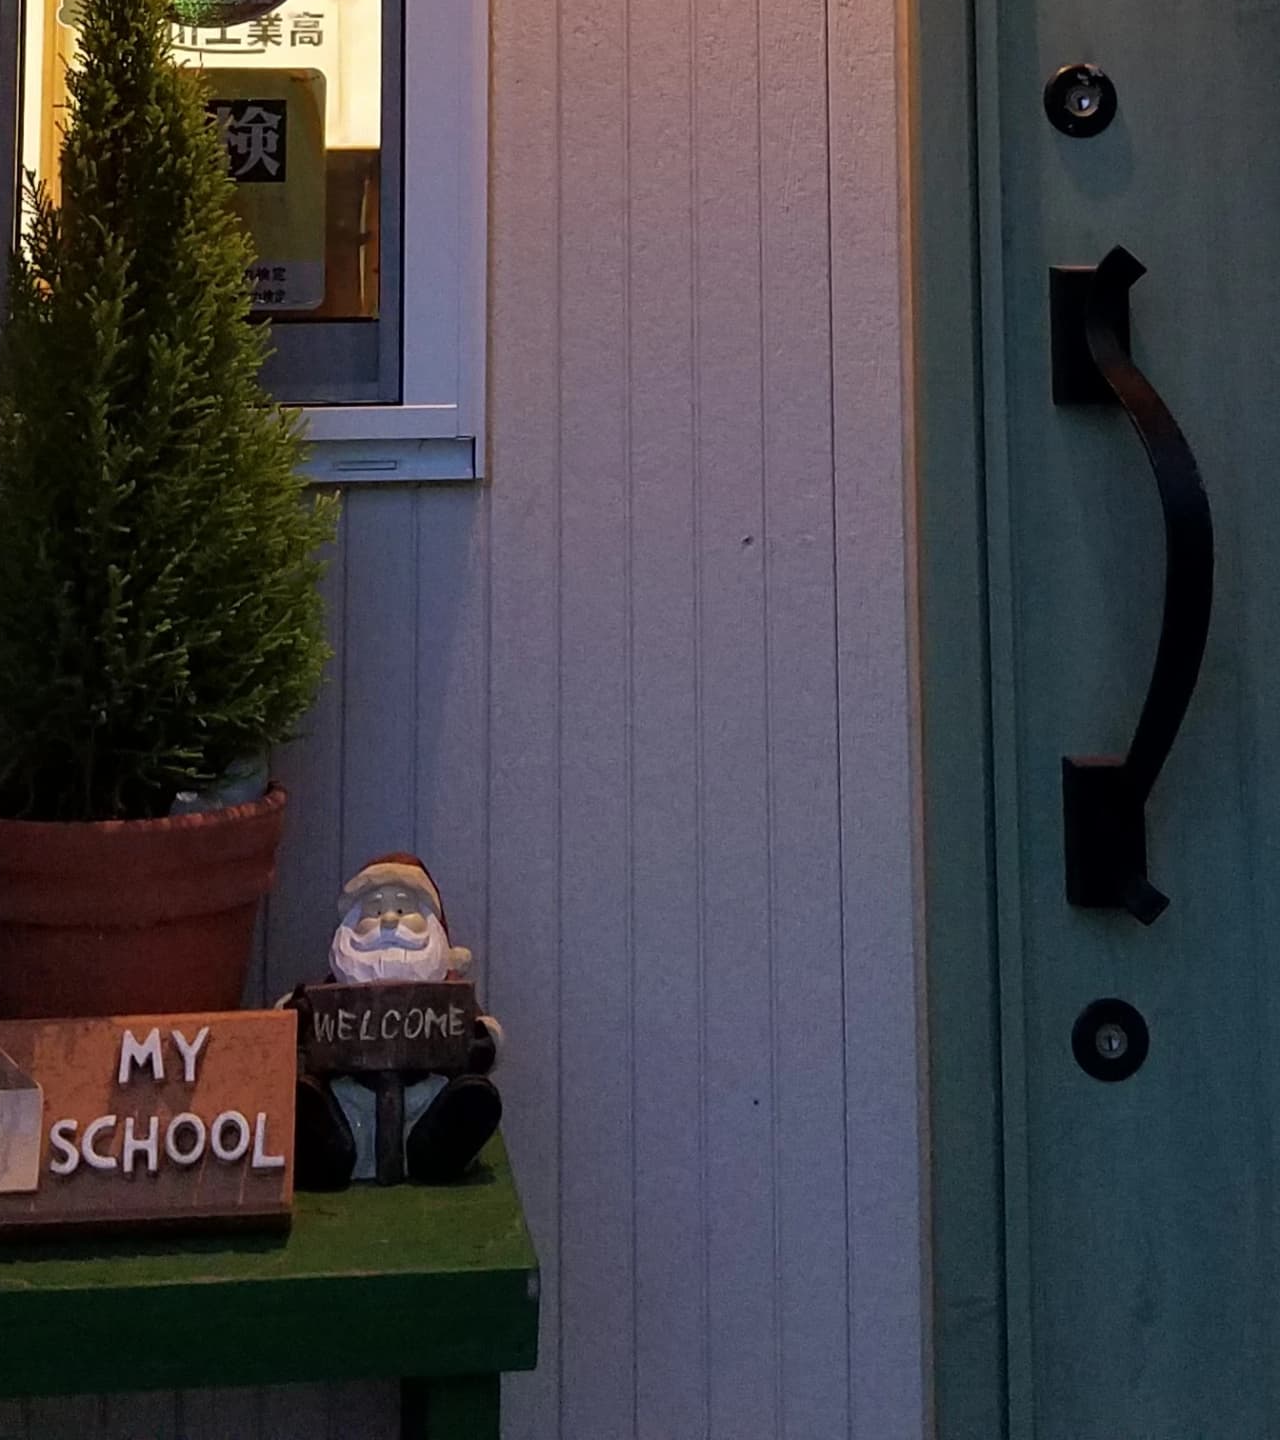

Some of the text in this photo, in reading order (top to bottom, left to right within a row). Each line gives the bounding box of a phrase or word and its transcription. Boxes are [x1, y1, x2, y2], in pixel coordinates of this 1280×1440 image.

[314, 1007, 466, 1043] WELCOME
[119, 1027, 210, 1084] MY
[49, 1110, 286, 1175] SCHOOL
